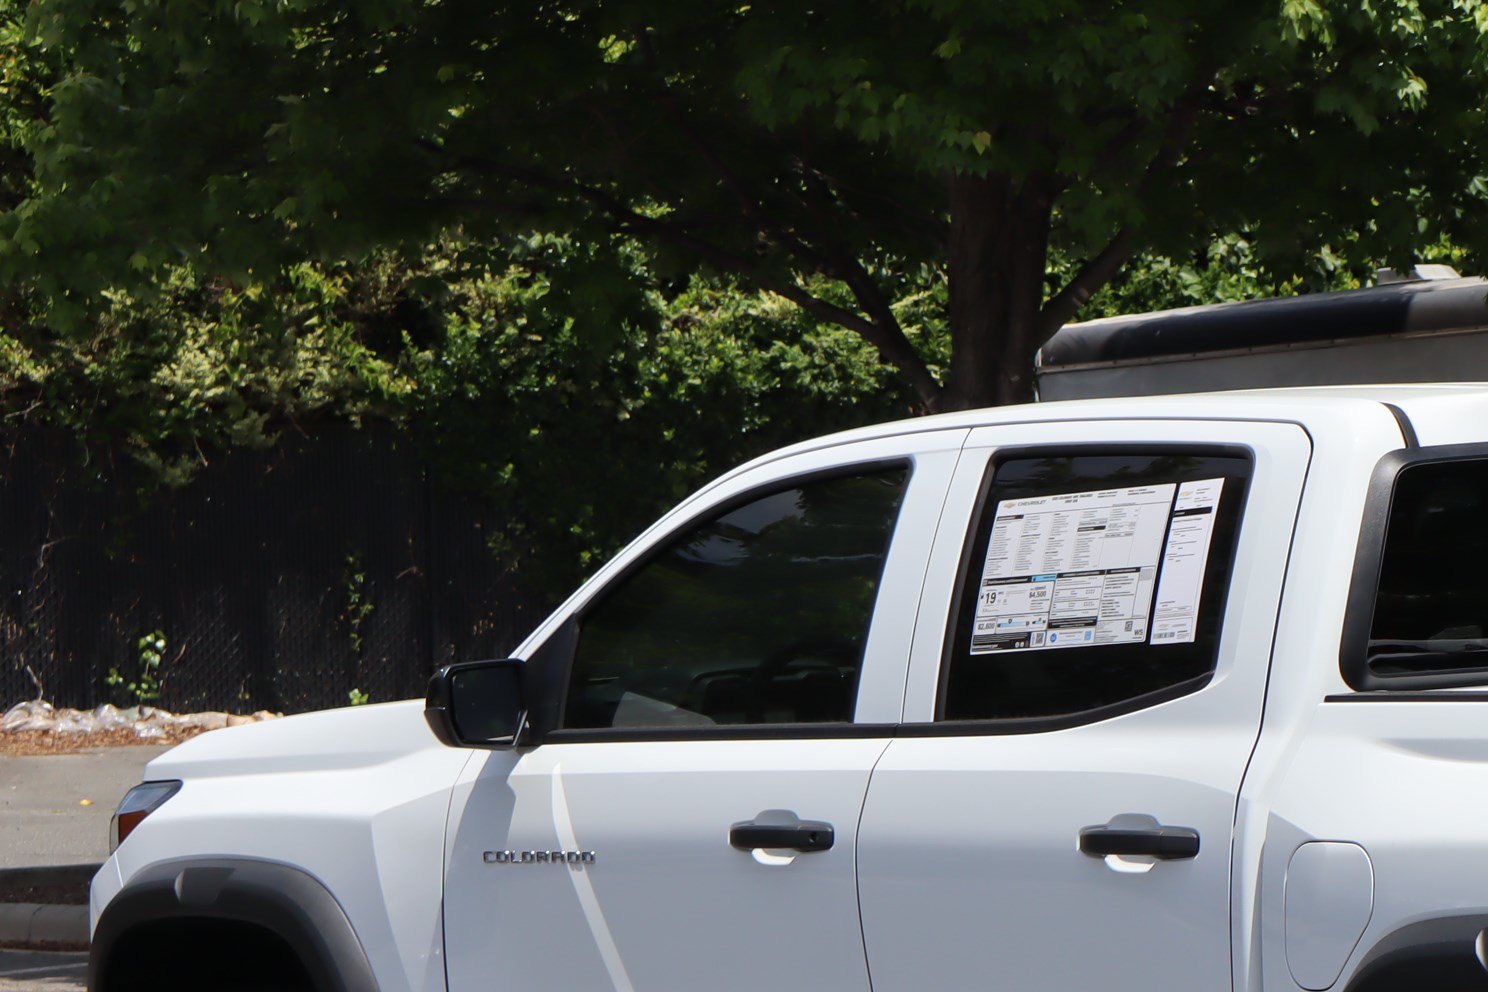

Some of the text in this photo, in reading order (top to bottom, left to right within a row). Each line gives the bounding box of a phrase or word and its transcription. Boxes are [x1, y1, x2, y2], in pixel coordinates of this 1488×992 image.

[1017, 499, 1046, 507] CHEVROLET
[985, 592, 997, 604] 19
[483, 850, 595, 863] COLORADO
